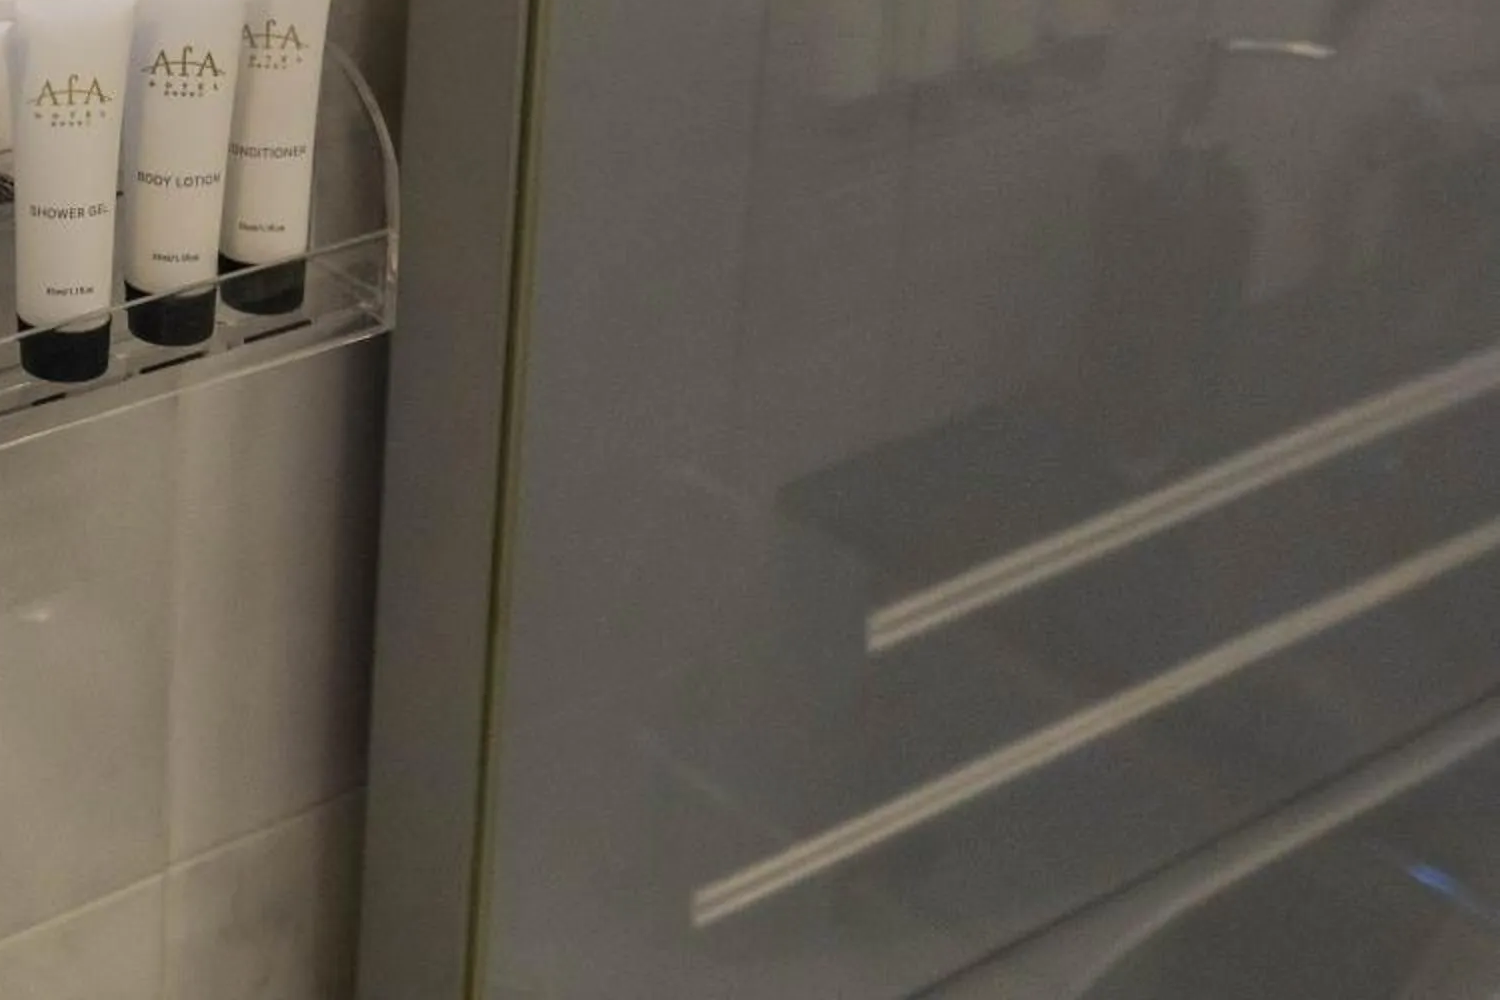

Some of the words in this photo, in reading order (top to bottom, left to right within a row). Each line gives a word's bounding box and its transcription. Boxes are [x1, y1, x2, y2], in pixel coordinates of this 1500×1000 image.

[147, 46, 221, 77] AfA
[33, 74, 108, 106] AfA
[228, 143, 307, 160] ONDITIONER
[137, 170, 171, 188] BODY
[175, 170, 221, 189] LOTION
[29, 203, 85, 219] SHOWER
[87, 203, 110, 218] GEL
